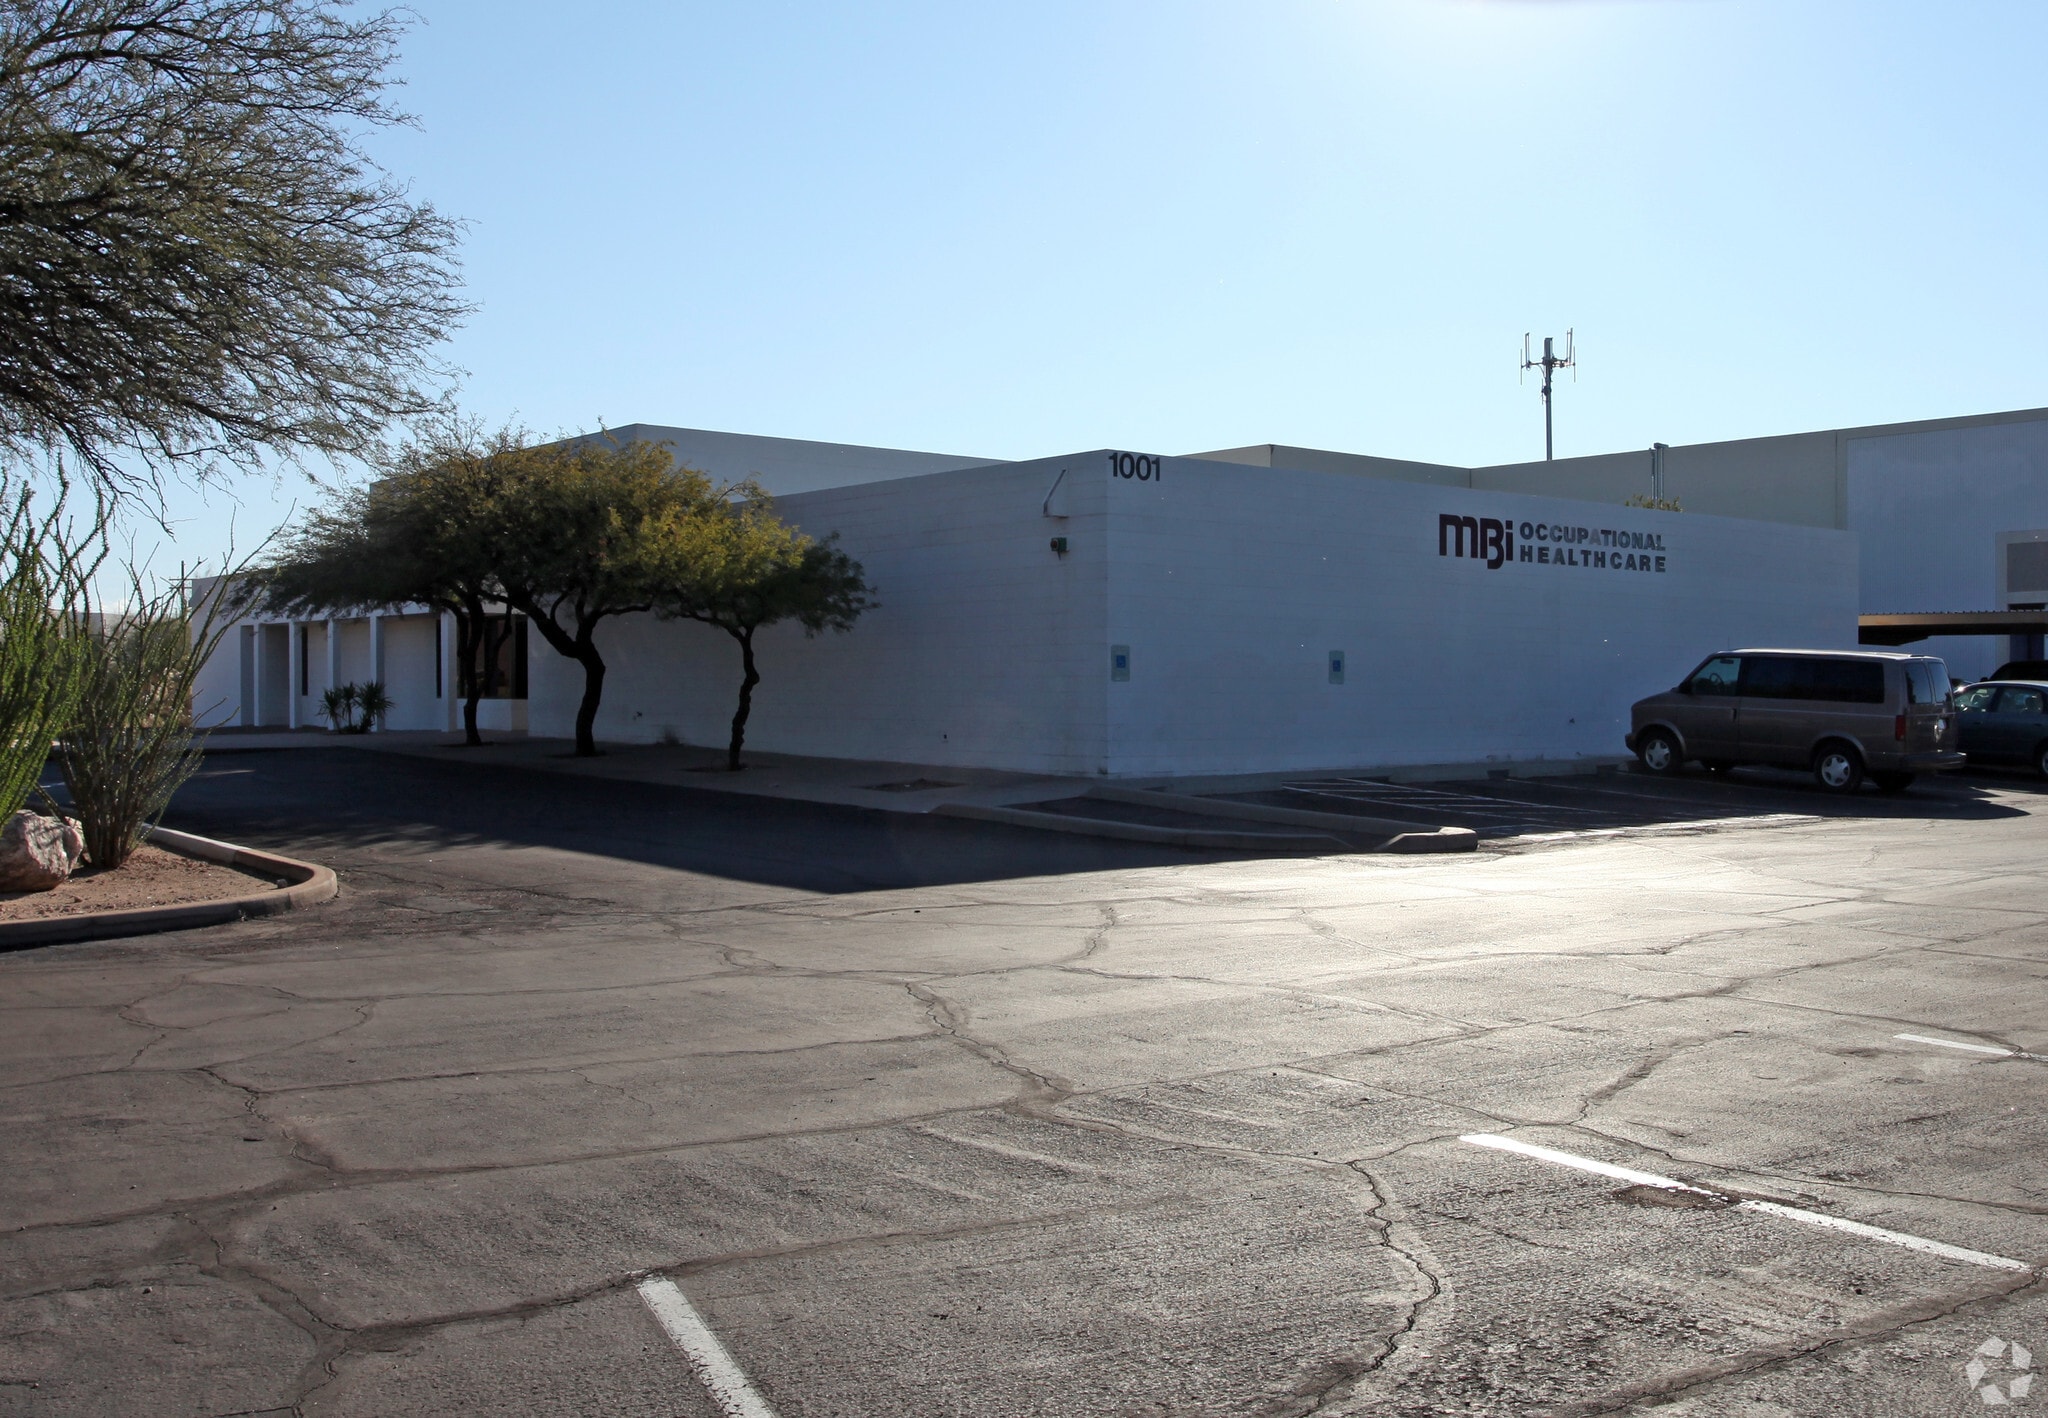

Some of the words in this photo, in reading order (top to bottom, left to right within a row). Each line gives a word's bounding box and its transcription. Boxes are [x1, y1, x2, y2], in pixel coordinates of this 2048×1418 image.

[1108, 452, 1160, 481] 1001
[1519, 521, 1666, 551] OCCUPATIONAL
[1519, 544, 1666, 573] HEALTHCARE
